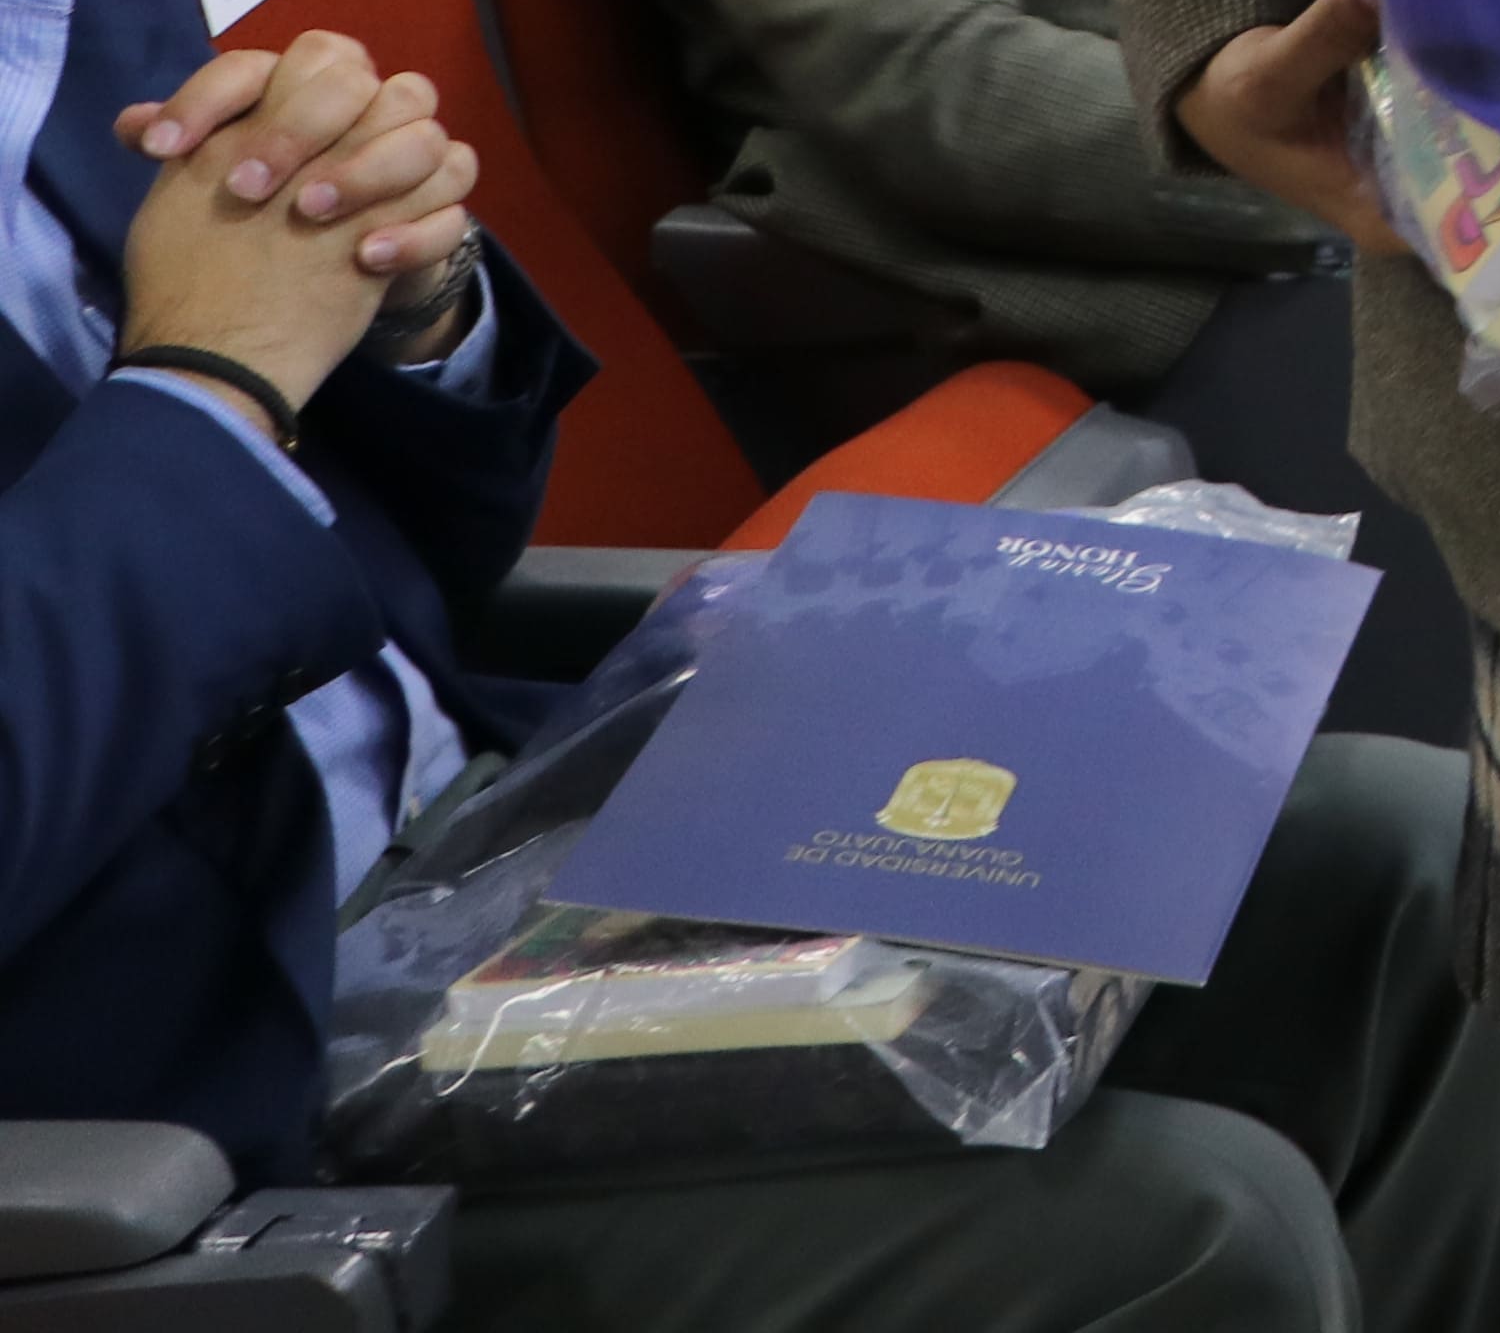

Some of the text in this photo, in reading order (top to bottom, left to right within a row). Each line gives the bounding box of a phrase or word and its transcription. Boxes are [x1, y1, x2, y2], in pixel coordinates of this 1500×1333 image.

[996, 536, 1138, 568] HONOR
[1038, 560, 1173, 595] Gloria
[812, 829, 1024, 866] GUANAJUATO
[784, 844, 1041, 888] UNIVERSIDAD DE
